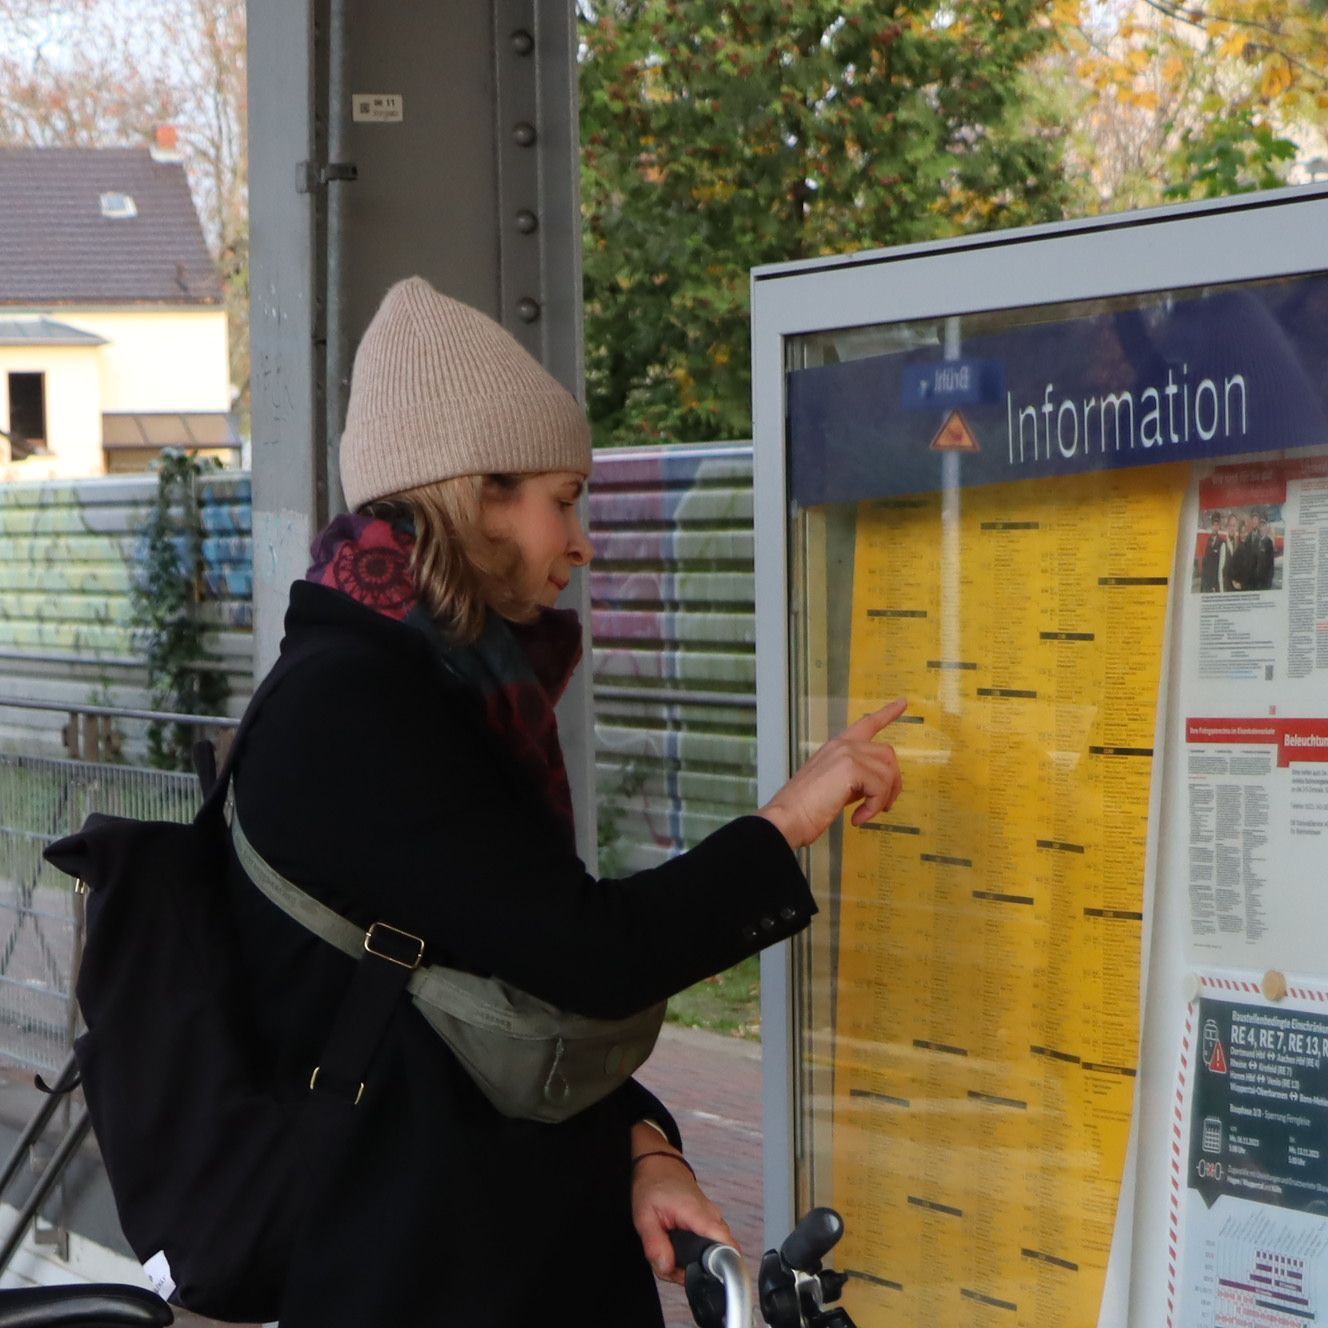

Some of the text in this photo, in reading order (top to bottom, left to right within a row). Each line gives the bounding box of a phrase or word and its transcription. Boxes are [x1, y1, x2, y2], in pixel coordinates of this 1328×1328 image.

[1006, 363, 1248, 465] Information
[1231, 1024, 1246, 1044] RE
[1247, 1027, 1257, 1049] 4,
[1259, 1028, 1275, 1049] RE
[1276, 1031, 1286, 1053] 7,
[1288, 1033, 1303, 1053] RE
[1306, 1035, 1321, 1059] 13,
